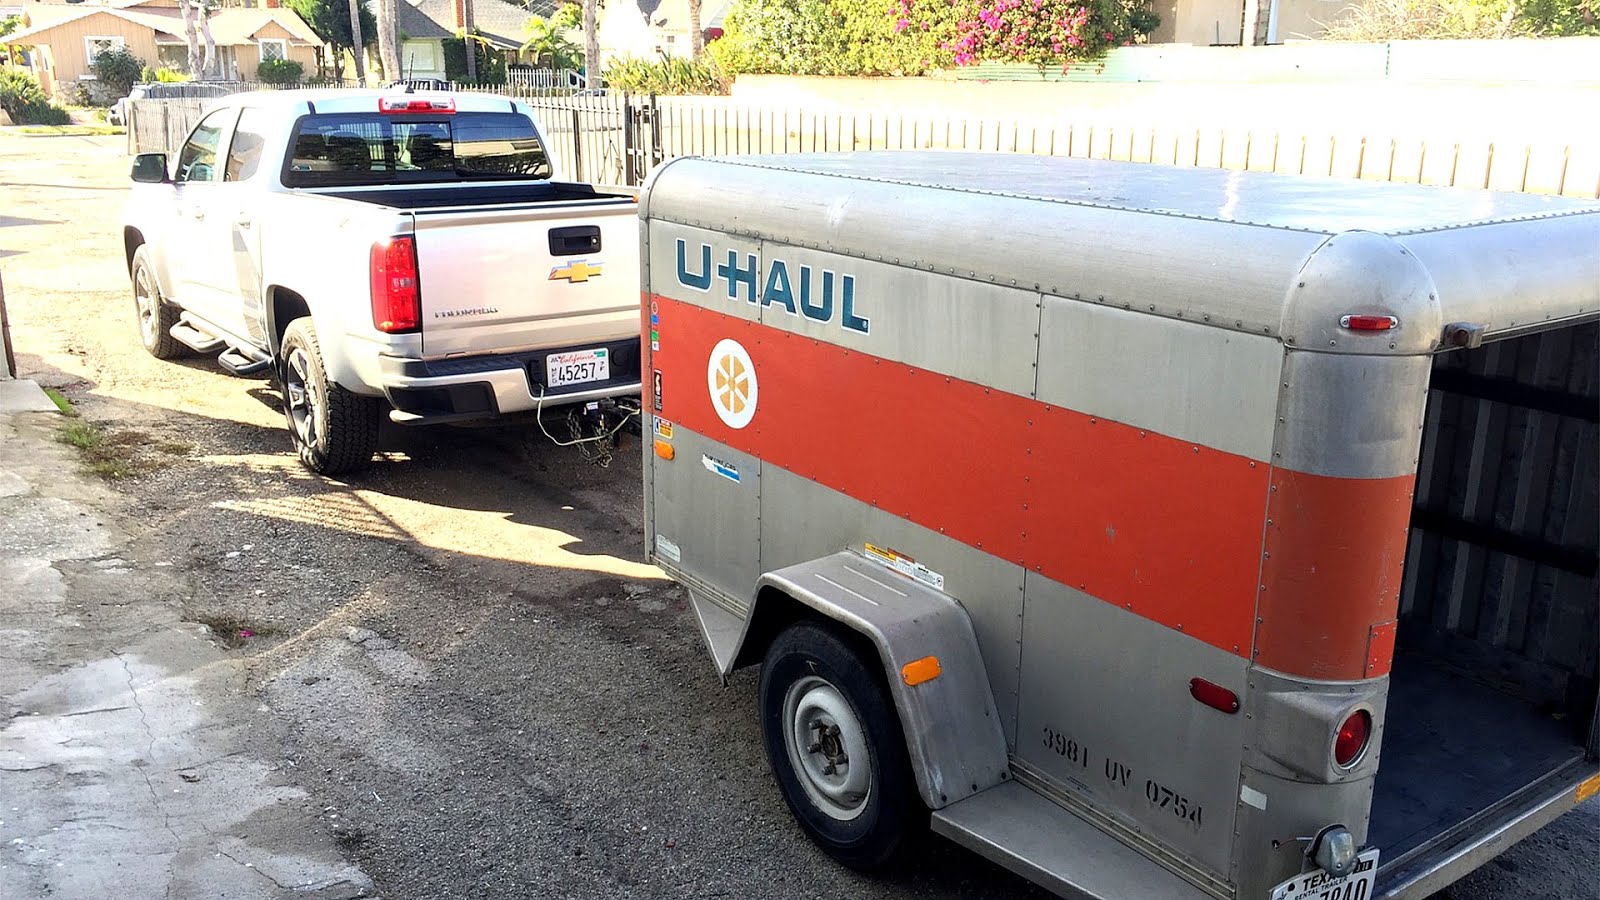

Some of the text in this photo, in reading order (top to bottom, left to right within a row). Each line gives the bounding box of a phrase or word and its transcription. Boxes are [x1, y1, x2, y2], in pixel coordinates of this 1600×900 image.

[676, 238, 870, 335] U-HAUL
[558, 362, 596, 382] 45257
[1043, 727, 1088, 768] 3981
[1105, 757, 1132, 787] UV
[1145, 779, 1202, 825] 0754
